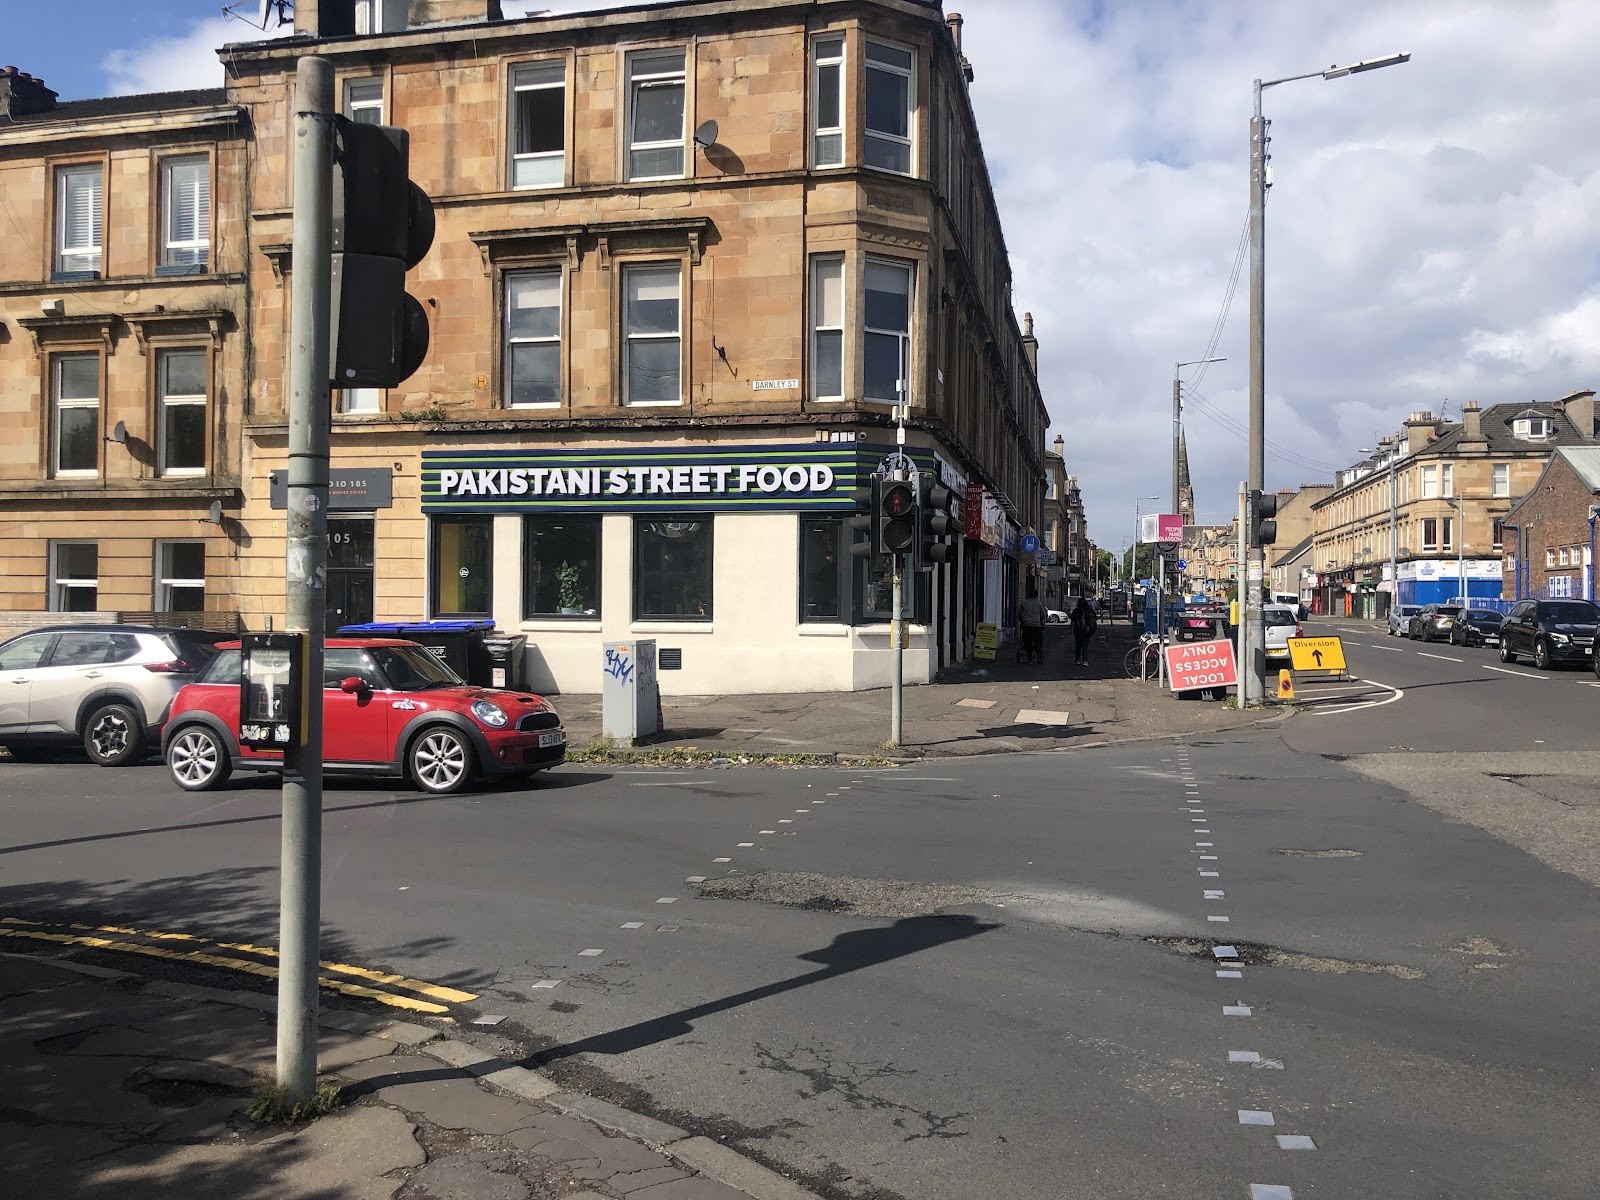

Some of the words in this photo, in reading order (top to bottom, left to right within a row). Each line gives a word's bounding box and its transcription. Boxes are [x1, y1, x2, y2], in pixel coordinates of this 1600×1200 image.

[755, 380, 785, 389] DARNLEY
[787, 380, 797, 388] ST
[350, 480, 367, 488] 105
[440, 468, 600, 495] PAKISTANI
[608, 467, 731, 494] STREET
[739, 464, 833, 493] FOOD
[326, 533, 351, 543] 105
[1182, 645, 1216, 658] ONLY
[1175, 656, 1228, 673] ACCESS
[1182, 672, 1225, 686] LOCAL
